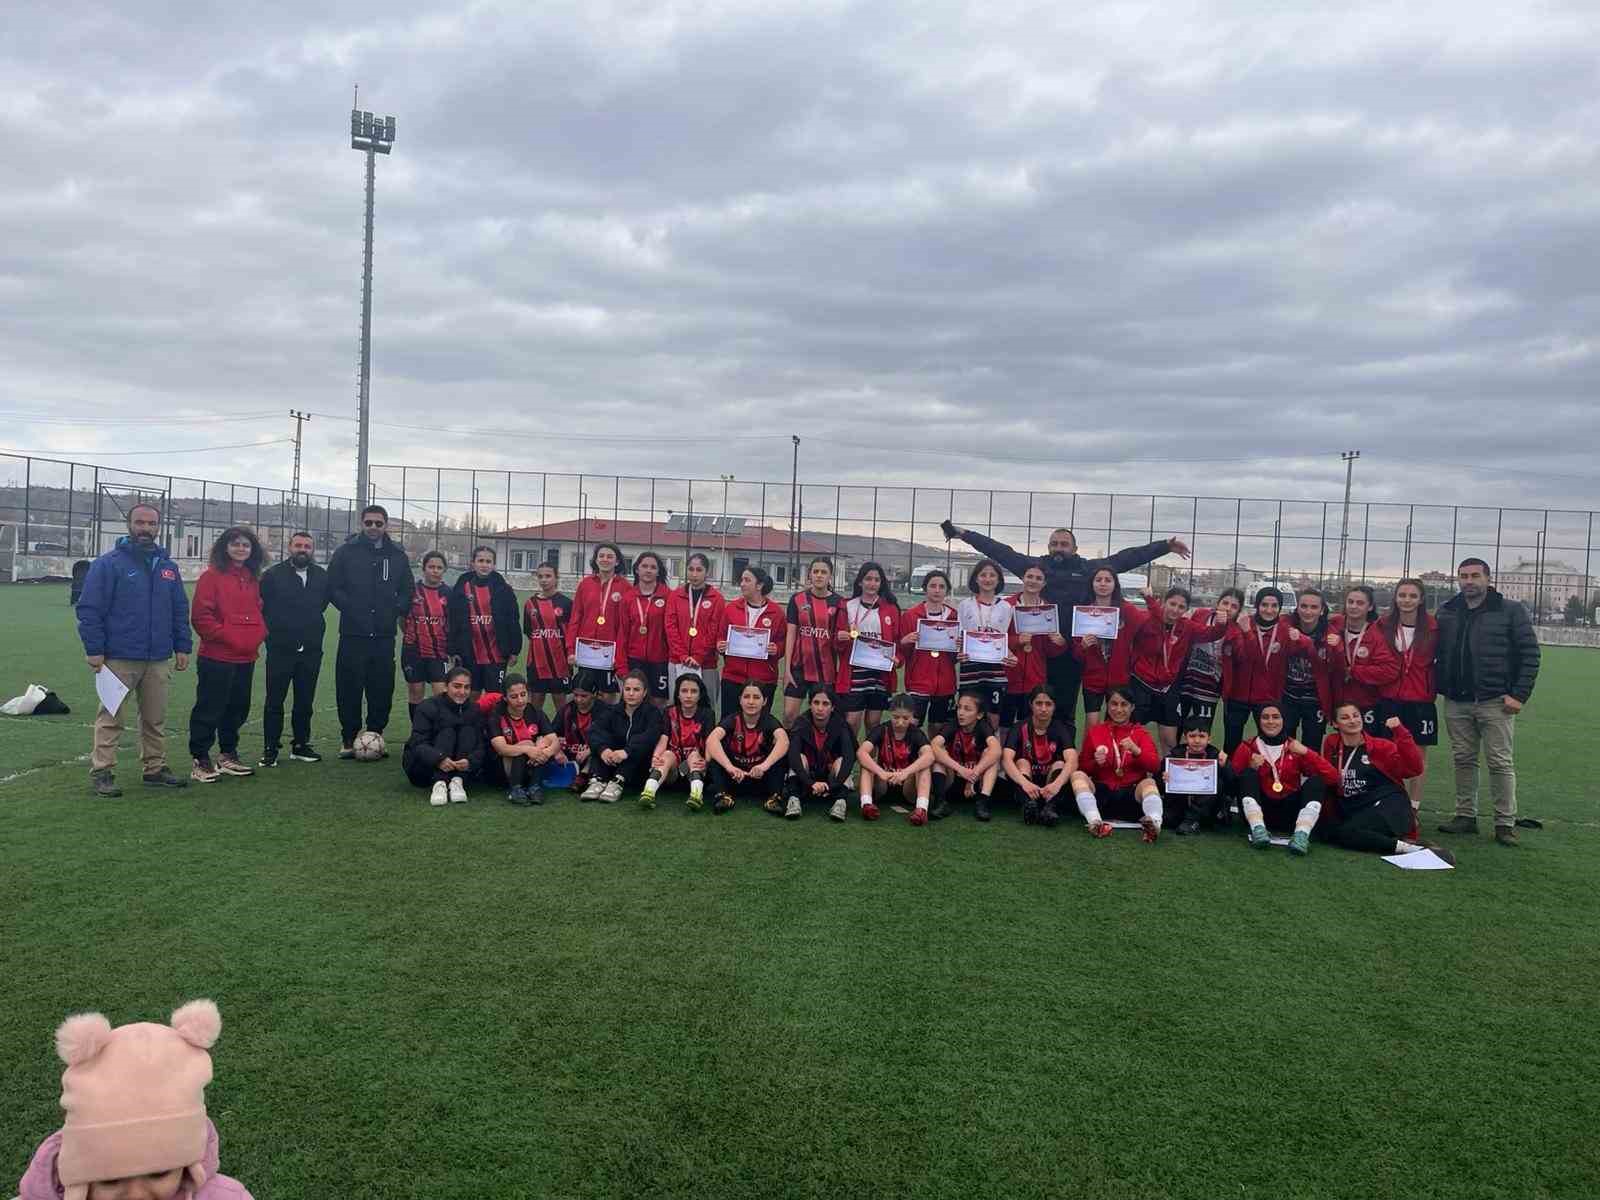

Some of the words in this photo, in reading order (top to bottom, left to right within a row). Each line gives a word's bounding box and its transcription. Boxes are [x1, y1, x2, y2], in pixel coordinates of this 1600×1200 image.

[658, 675, 667, 690] 5
[991, 691, 1000, 704] 3
[1199, 705, 1212, 718] 11
[1363, 710, 1375, 724] 6
[1420, 719, 1434, 735] 13
